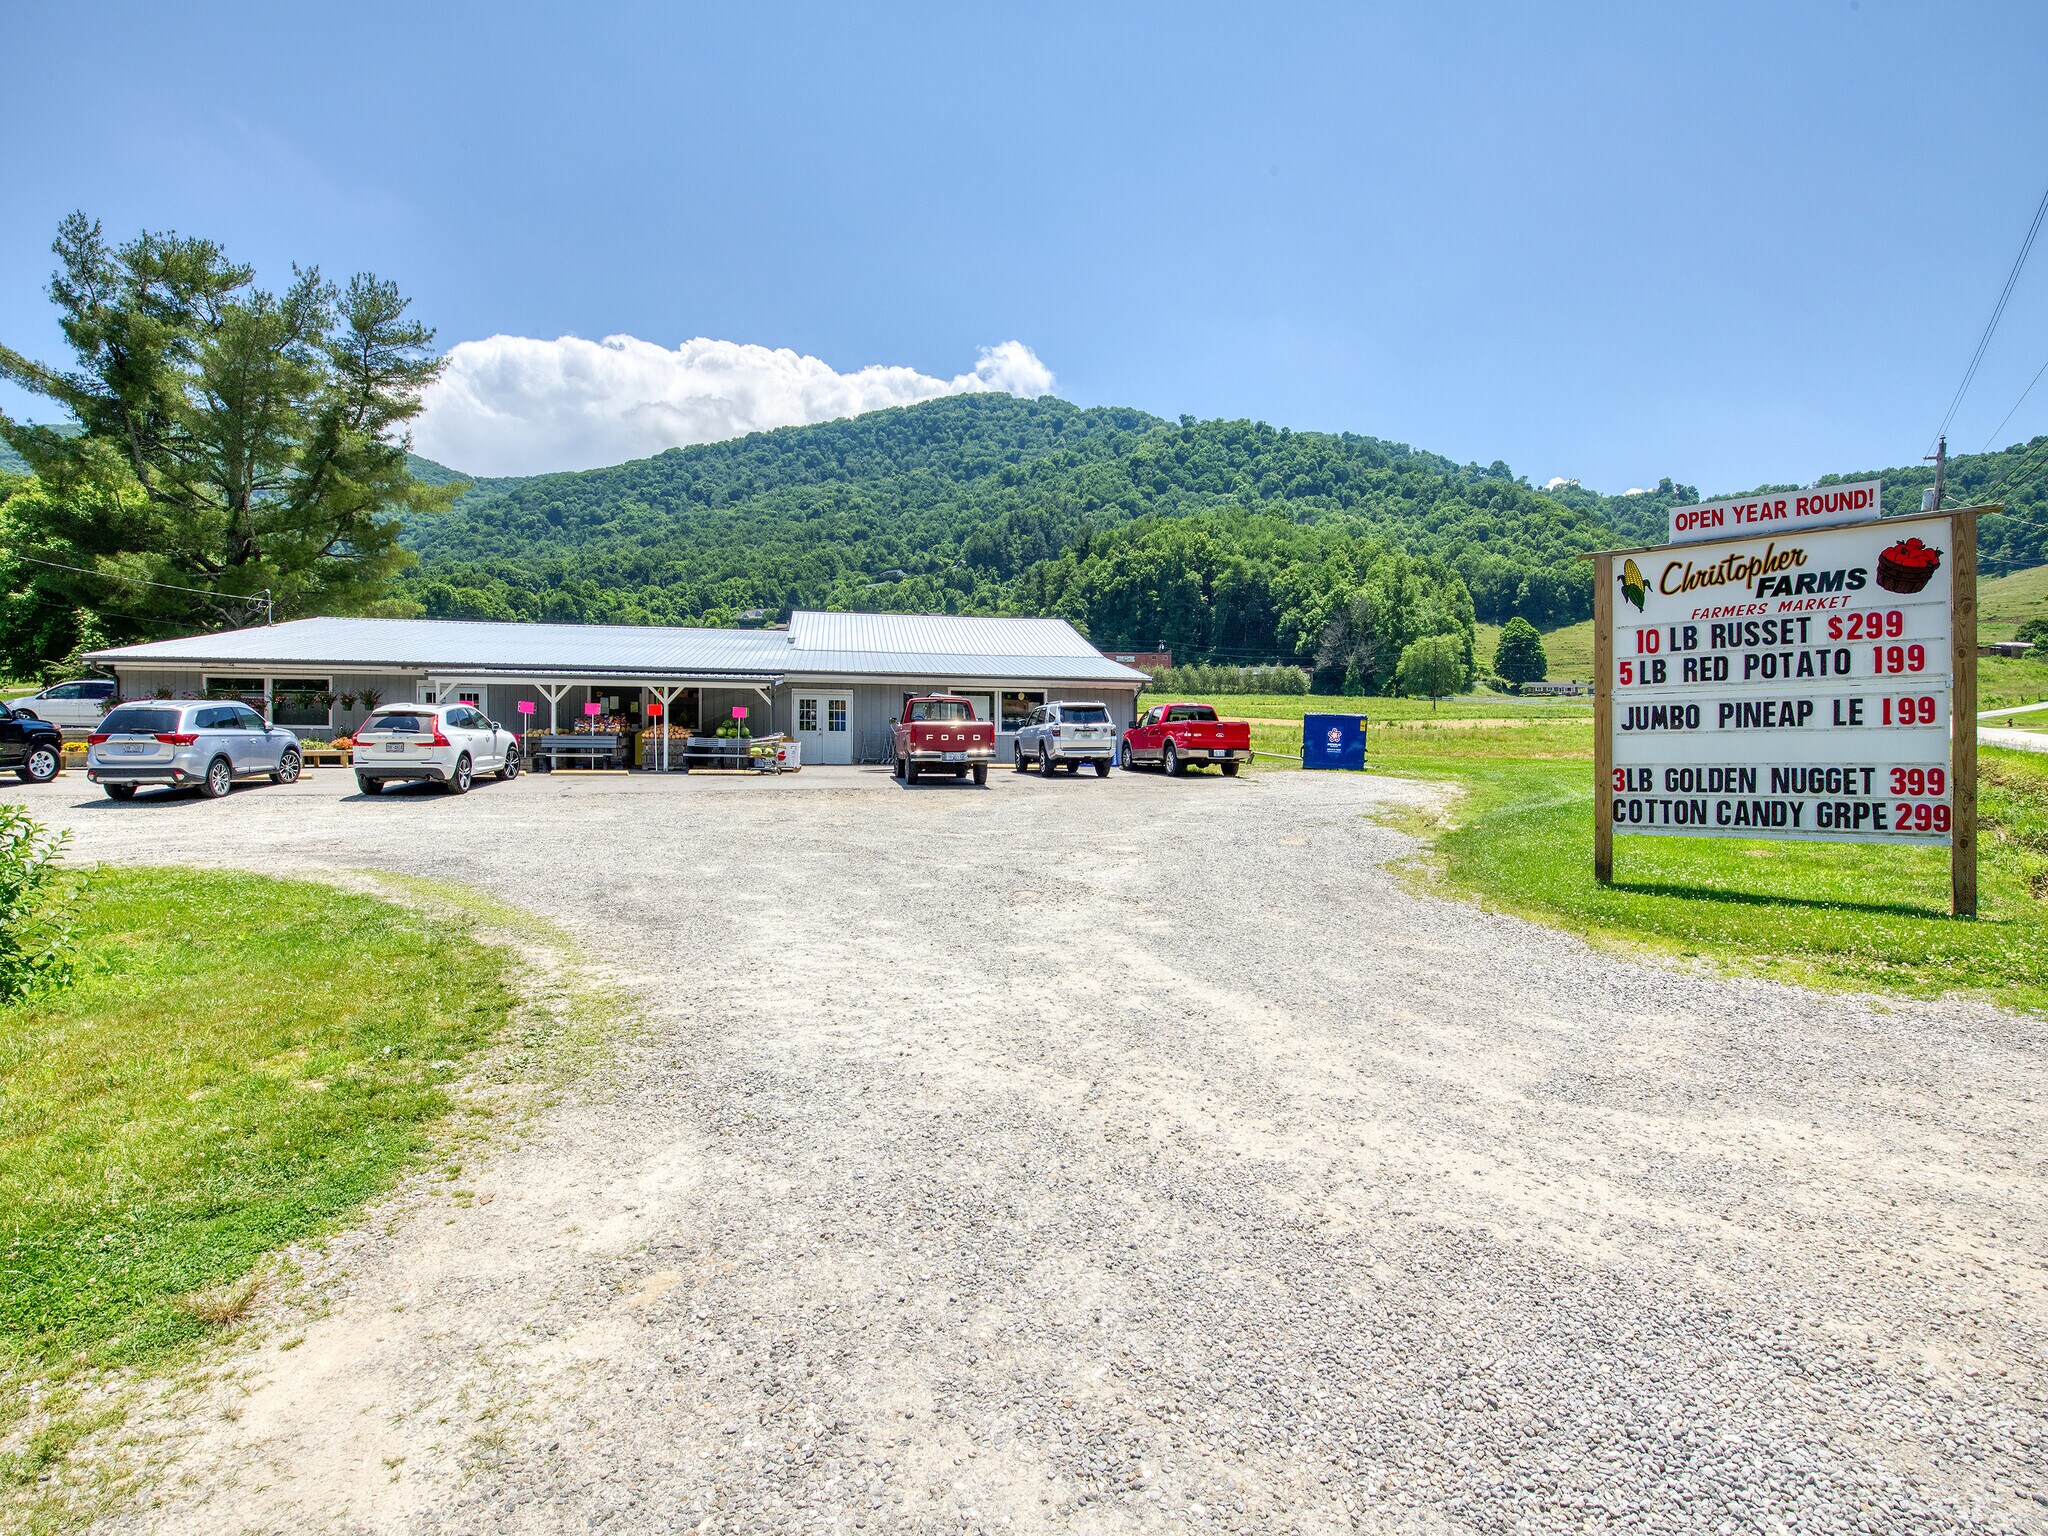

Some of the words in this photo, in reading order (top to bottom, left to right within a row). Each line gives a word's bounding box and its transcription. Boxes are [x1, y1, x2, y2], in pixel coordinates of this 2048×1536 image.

[1675, 508, 1724, 532] OPEN
[1732, 500, 1787, 524] YEAR
[1796, 488, 1874, 517] ROUND!
[1660, 542, 1807, 595] Christopher
[1755, 567, 1868, 599] FARMS
[1691, 602, 1769, 621] FARMERS
[1778, 595, 1852, 613] MARKET
[1636, 629, 1660, 654] 10
[1670, 625, 1699, 652] LB
[1711, 616, 1811, 650] RUSSET
[1828, 610, 1904, 642] $299
[1683, 656, 1729, 683] RED
[1744, 648, 1852, 681] POTATO
[1873, 644, 1926, 674] 199
[1621, 703, 1701, 732] JUMBO
[1882, 696, 1937, 726] 199
[1664, 767, 1757, 794] GOLDEN
[1771, 767, 1876, 795] NUGGET
[1889, 767, 1946, 796] 399
[1613, 798, 1708, 826] COTTON
[1716, 799, 1805, 828] CANDY
[1816, 801, 1889, 831] GRPE
[1894, 802, 1952, 833] 299
